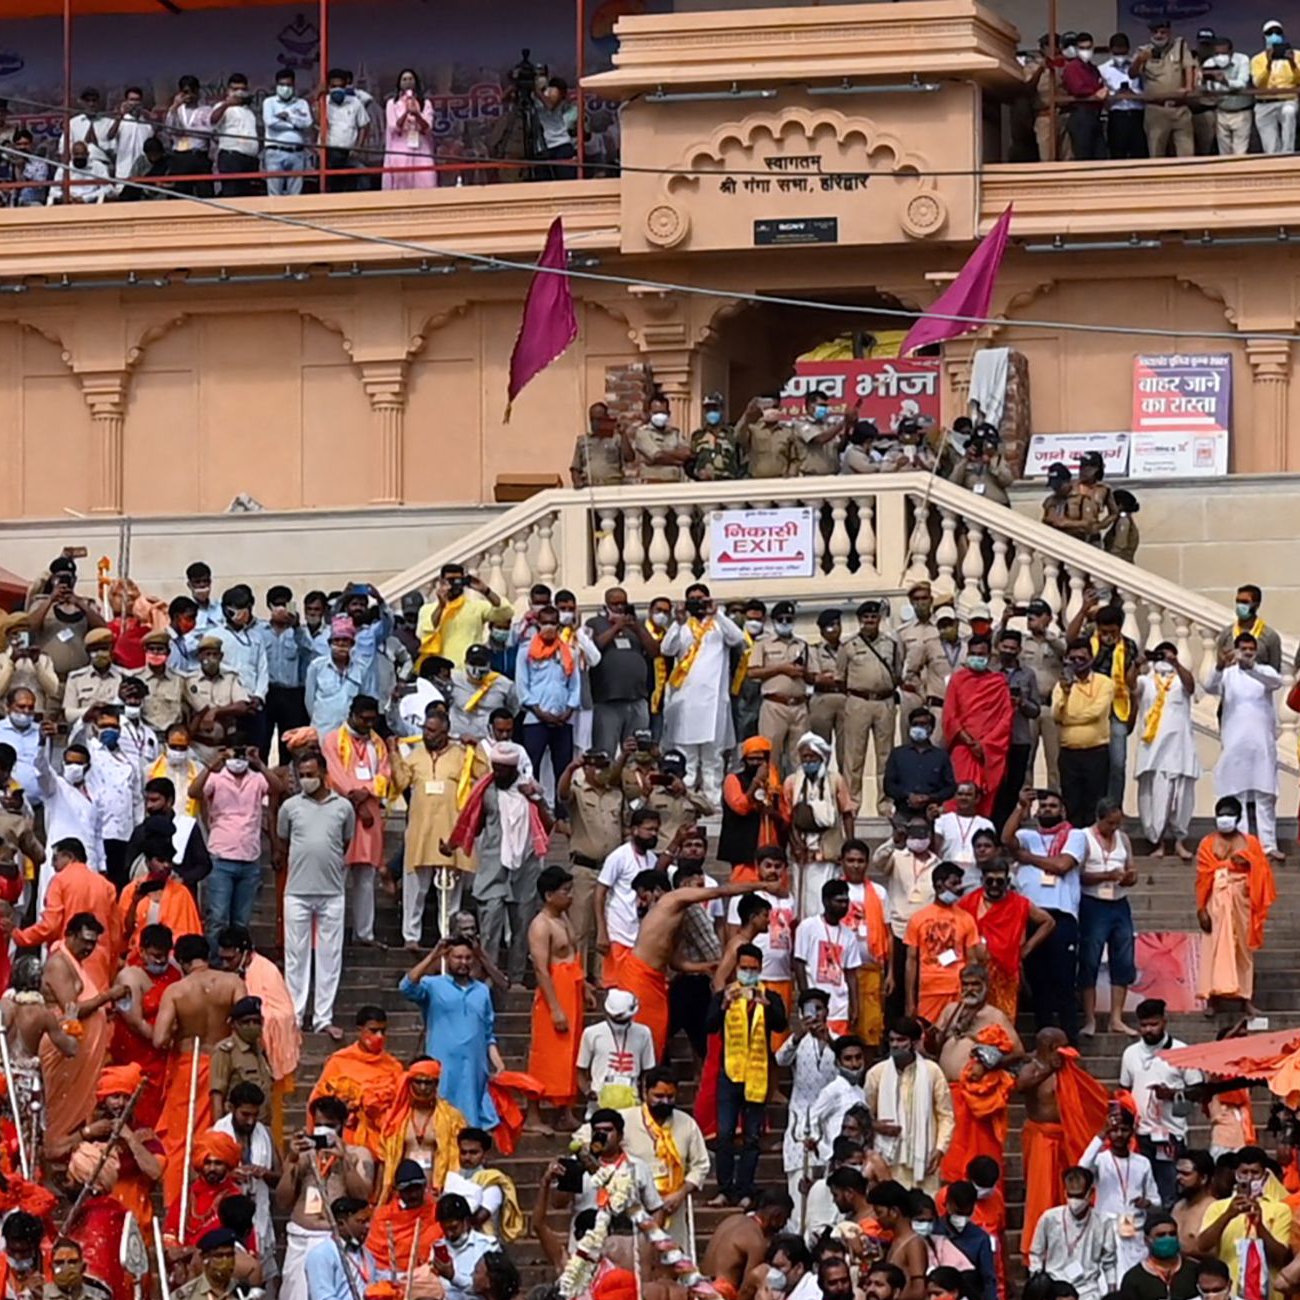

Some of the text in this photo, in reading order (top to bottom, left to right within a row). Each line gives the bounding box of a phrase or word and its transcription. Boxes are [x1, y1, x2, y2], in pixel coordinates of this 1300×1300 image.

[764, 155, 822, 173] स्वागतम्
[720, 177, 737, 194] श्री
[743, 177, 771, 194] गंगा
[1138, 371, 1221, 393] बाहर जाने
[1141, 397, 1217, 413] का रास्ता
[724, 521, 798, 538] निकासी
[733, 538, 789, 553] EXIT
